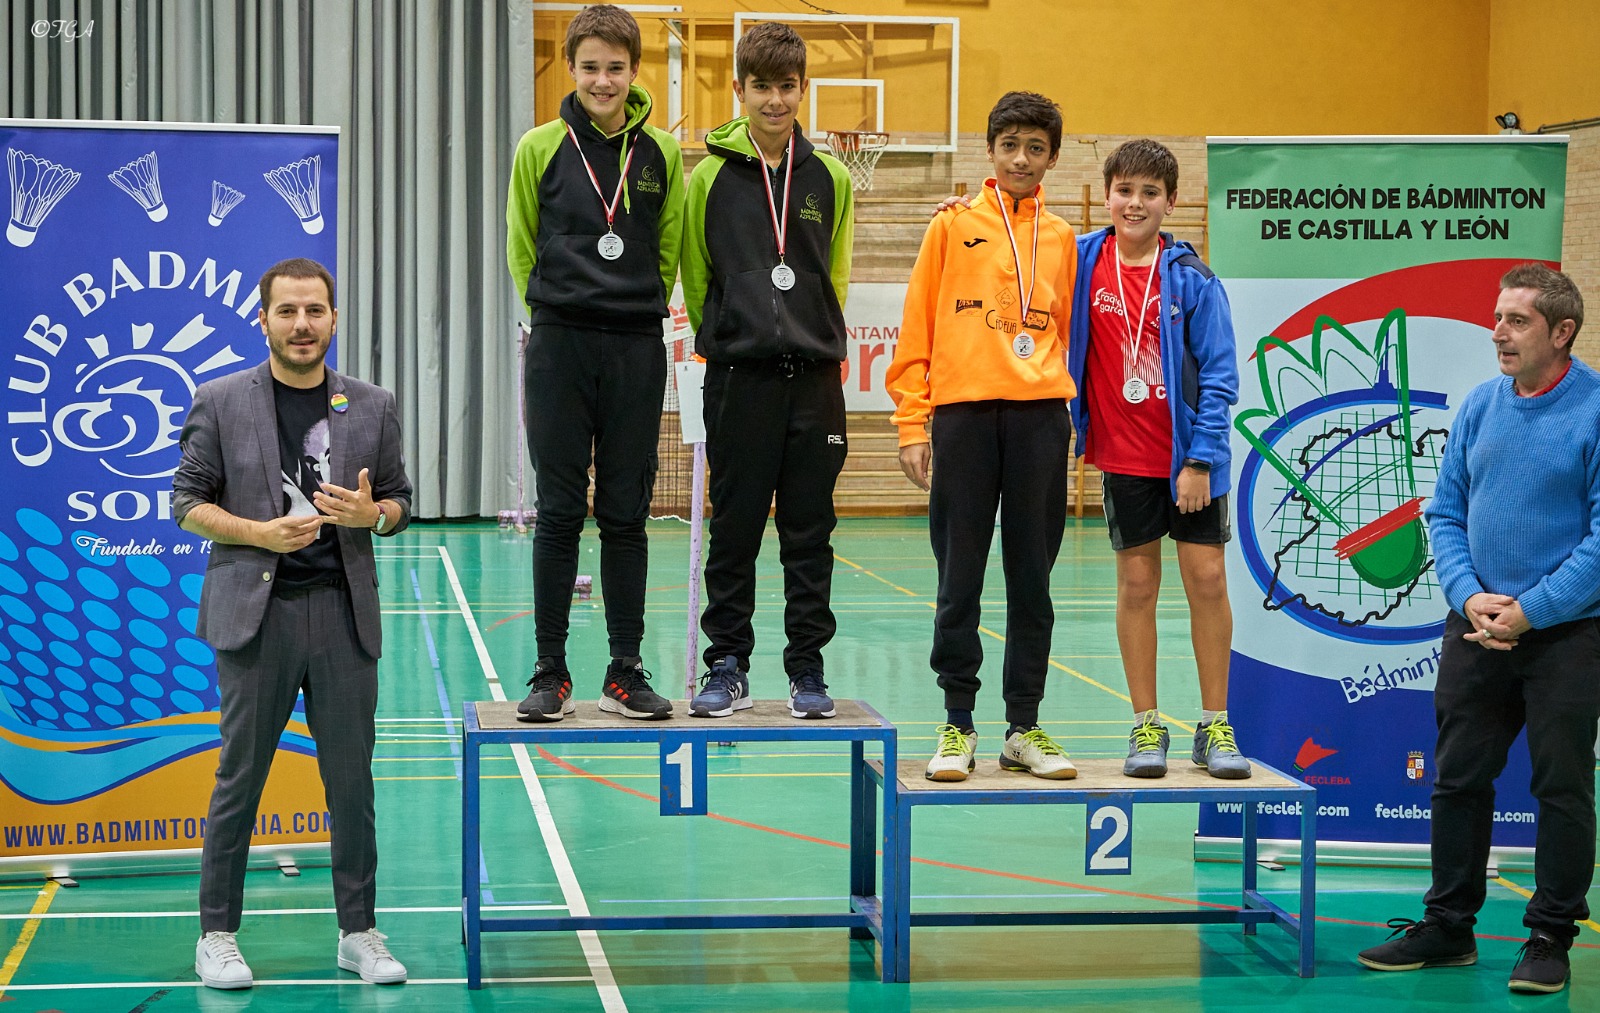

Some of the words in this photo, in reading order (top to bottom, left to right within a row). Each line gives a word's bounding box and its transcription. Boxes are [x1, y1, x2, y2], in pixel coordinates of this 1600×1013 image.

[1226, 184, 1366, 210] FEDERACIÓN
[1372, 188, 1401, 209] DE
[1407, 184, 1546, 209] BÁDMINTON
[1261, 219, 1291, 240] DE
[1298, 219, 1413, 240] CASTILLA
[1420, 219, 1438, 240] Y
[1445, 215, 1509, 240] LEÓN
[8, 314, 68, 467] CLUB
[827, 434, 845, 445] RSL
[76, 535, 166, 557] Fundado
[173, 543, 193, 555] en
[1340, 647, 1441, 704] Bádmint
[666, 742, 693, 808] 1
[1304, 775, 1351, 785] FECLEBA
[1089, 805, 1129, 869] 2
